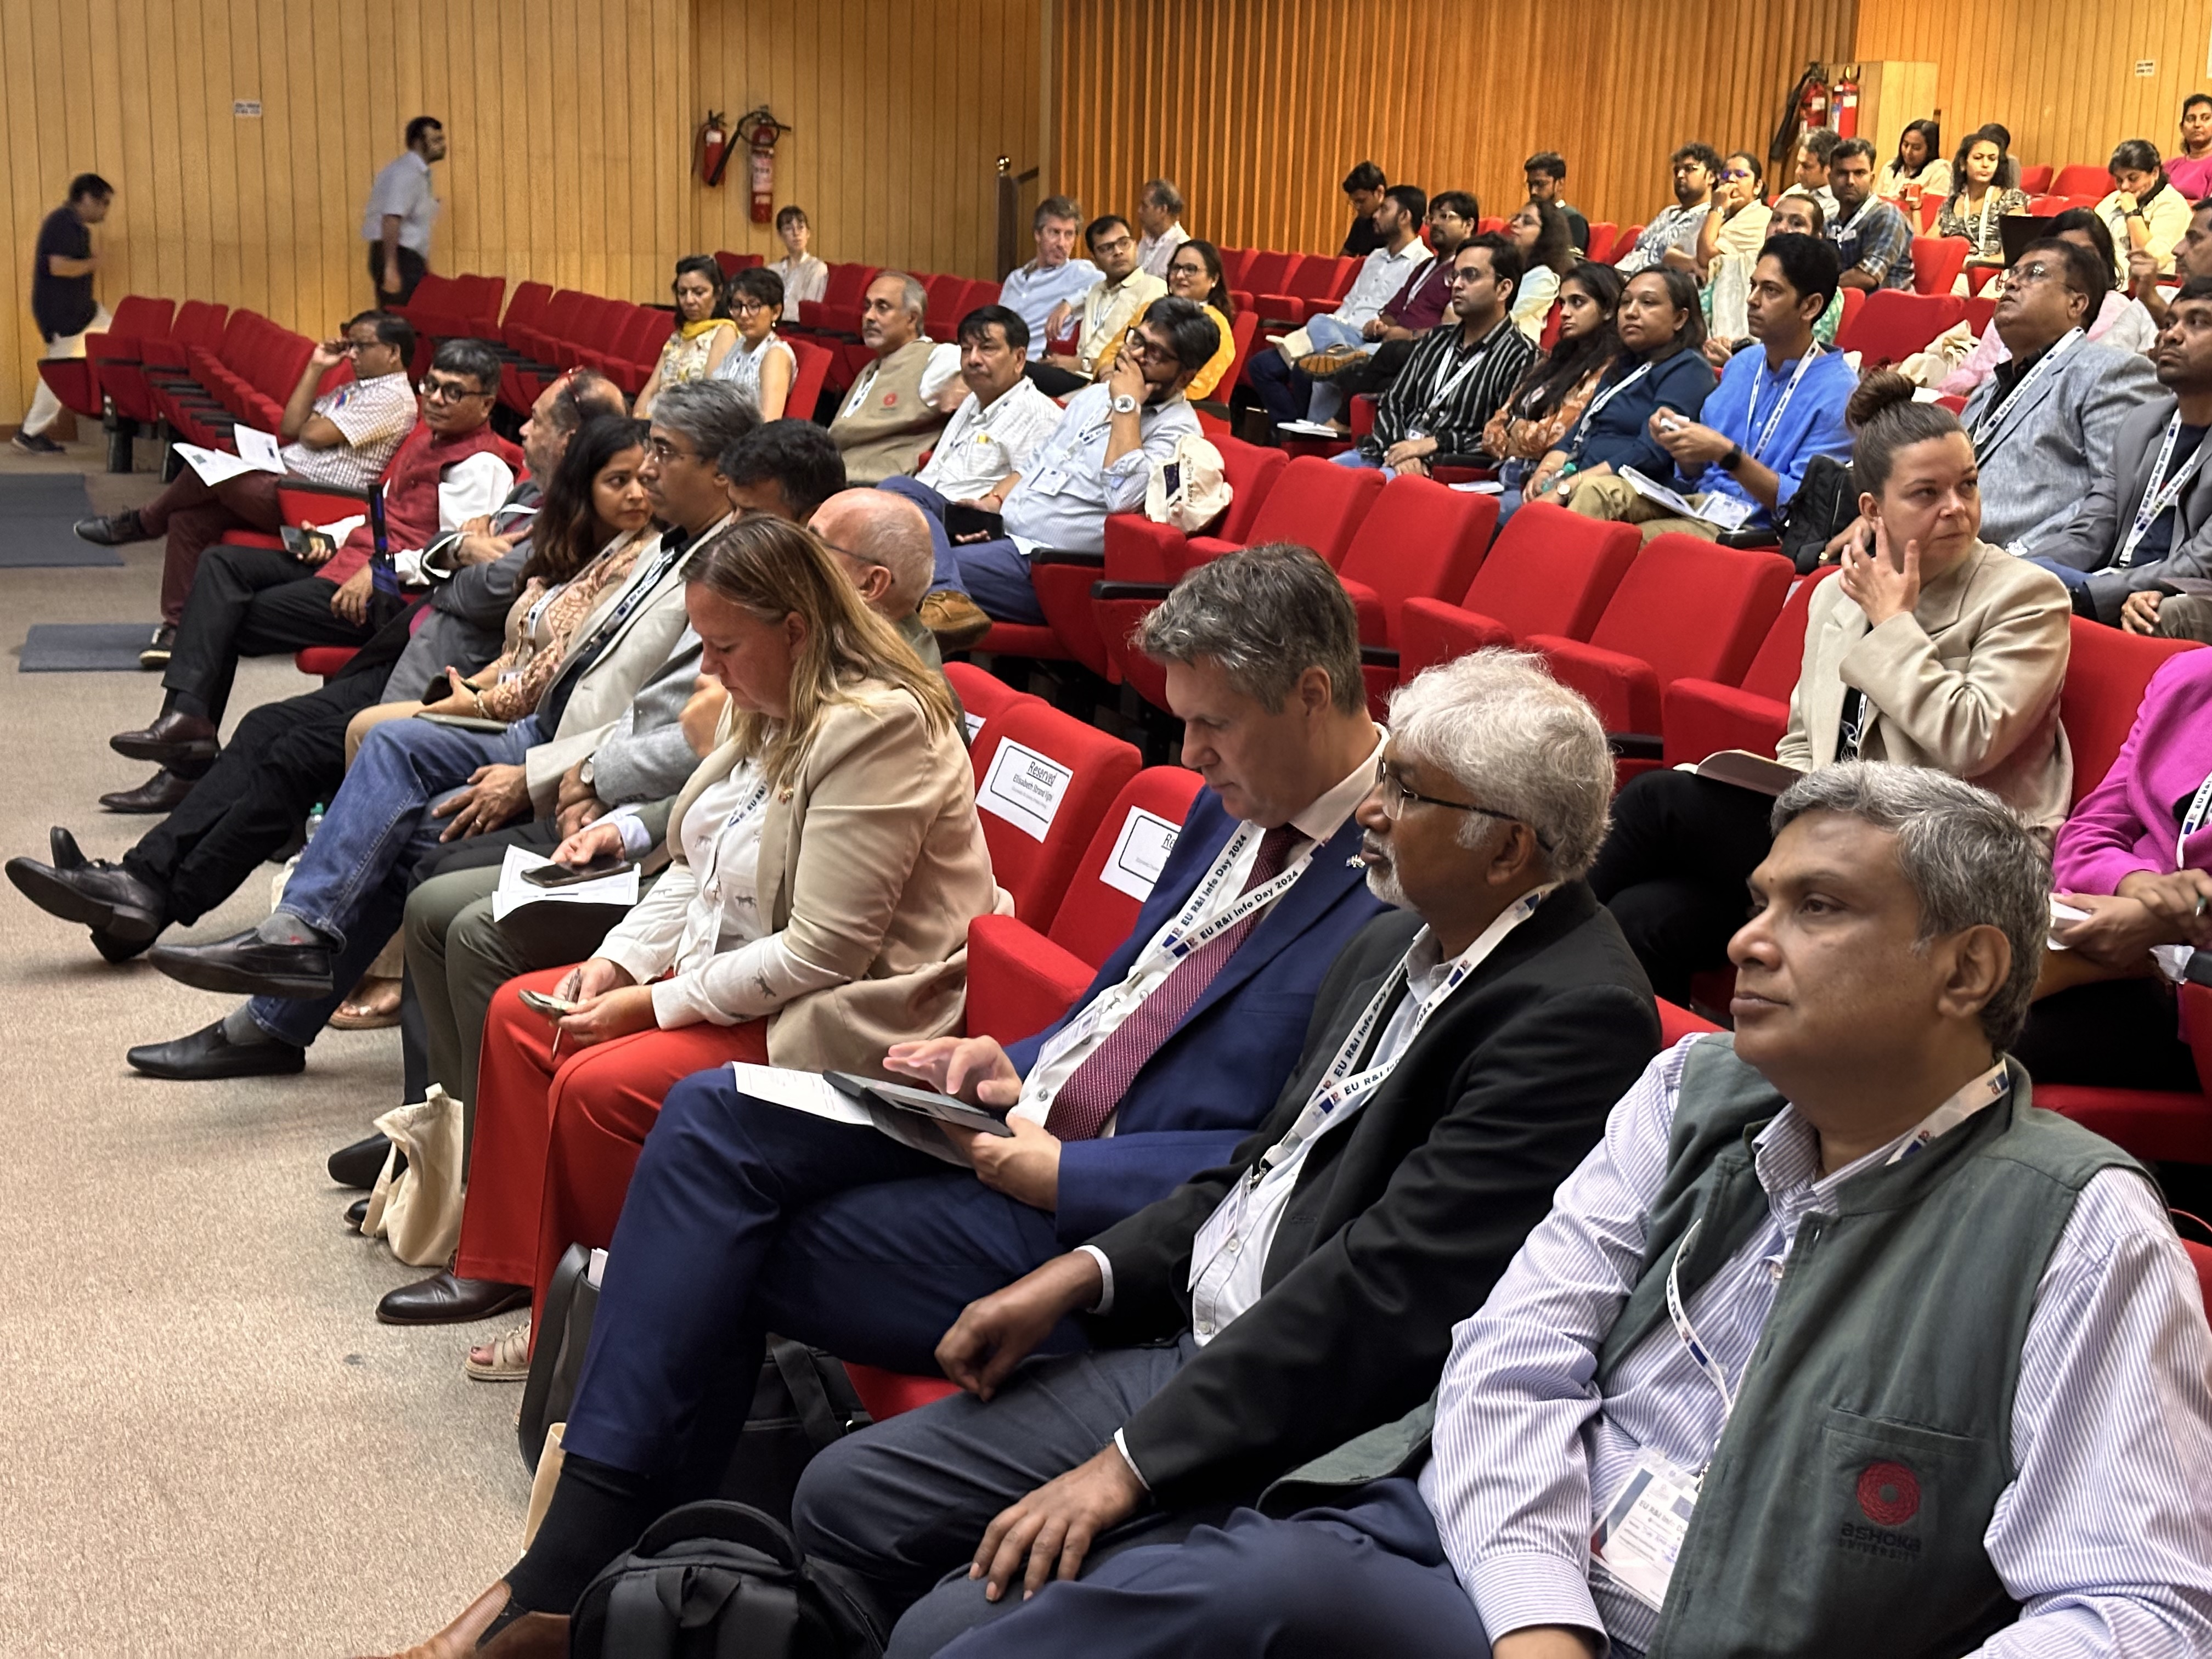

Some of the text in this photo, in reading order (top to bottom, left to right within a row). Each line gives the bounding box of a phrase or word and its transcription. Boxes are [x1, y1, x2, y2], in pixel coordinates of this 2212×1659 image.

[1028, 761, 1058, 785] Reserved
[1181, 834, 1247, 927] EU R&I Info Day 2024
[1199, 870, 1299, 940] EU R&I Info Day 2024
[1333, 1059, 1347, 1078] EU
[1345, 1037, 1361, 1060] R&I
[1358, 1013, 1374, 1037] Info
[1373, 990, 1387, 1013] Day
[1344, 1081, 1360, 1096] EU
[1363, 1070, 1384, 1086] R&I
[1671, 1301, 1680, 1322] EU
[1639, 1499, 1649, 1510] EU
